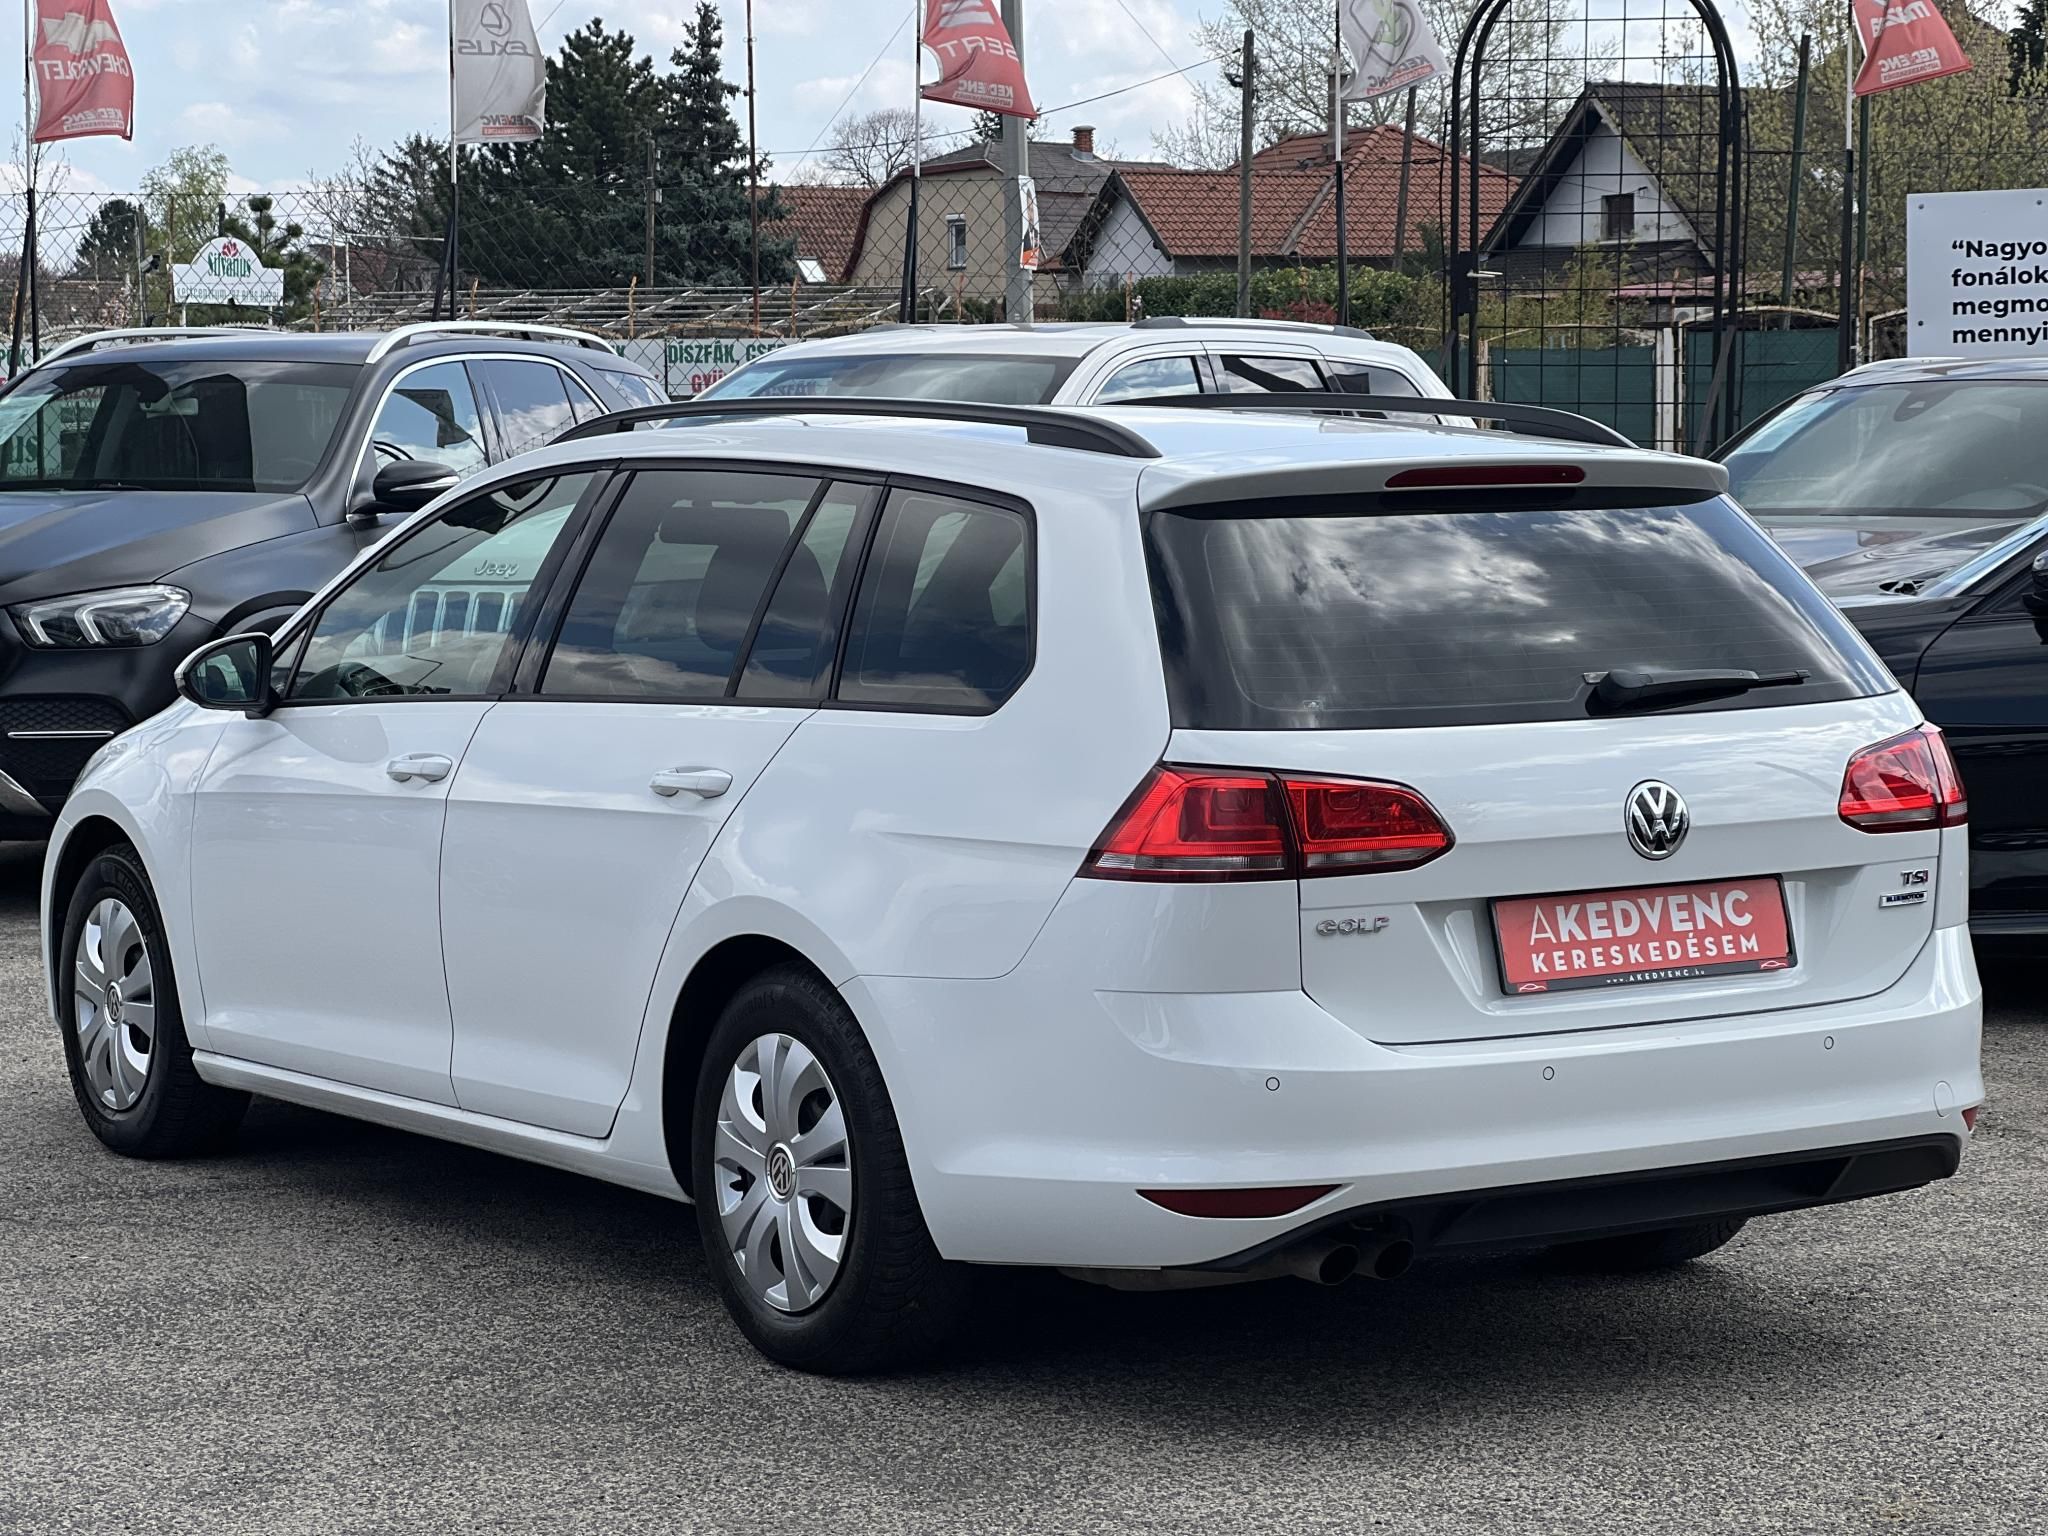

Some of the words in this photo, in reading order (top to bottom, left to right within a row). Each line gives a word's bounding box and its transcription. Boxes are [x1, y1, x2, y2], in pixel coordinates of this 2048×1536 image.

[207, 252, 252, 278] Silvanus
[1951, 265, 2048, 287] fonálok
[1952, 320, 2048, 346] mennyi
[667, 340, 739, 366] DÍSZFÁK,
[691, 369, 727, 393] GYÜ
[474, 559, 519, 579] Jeep
[1316, 916, 1390, 936] GOLF
[1531, 932, 1760, 974] KERESKEDÉSEM
